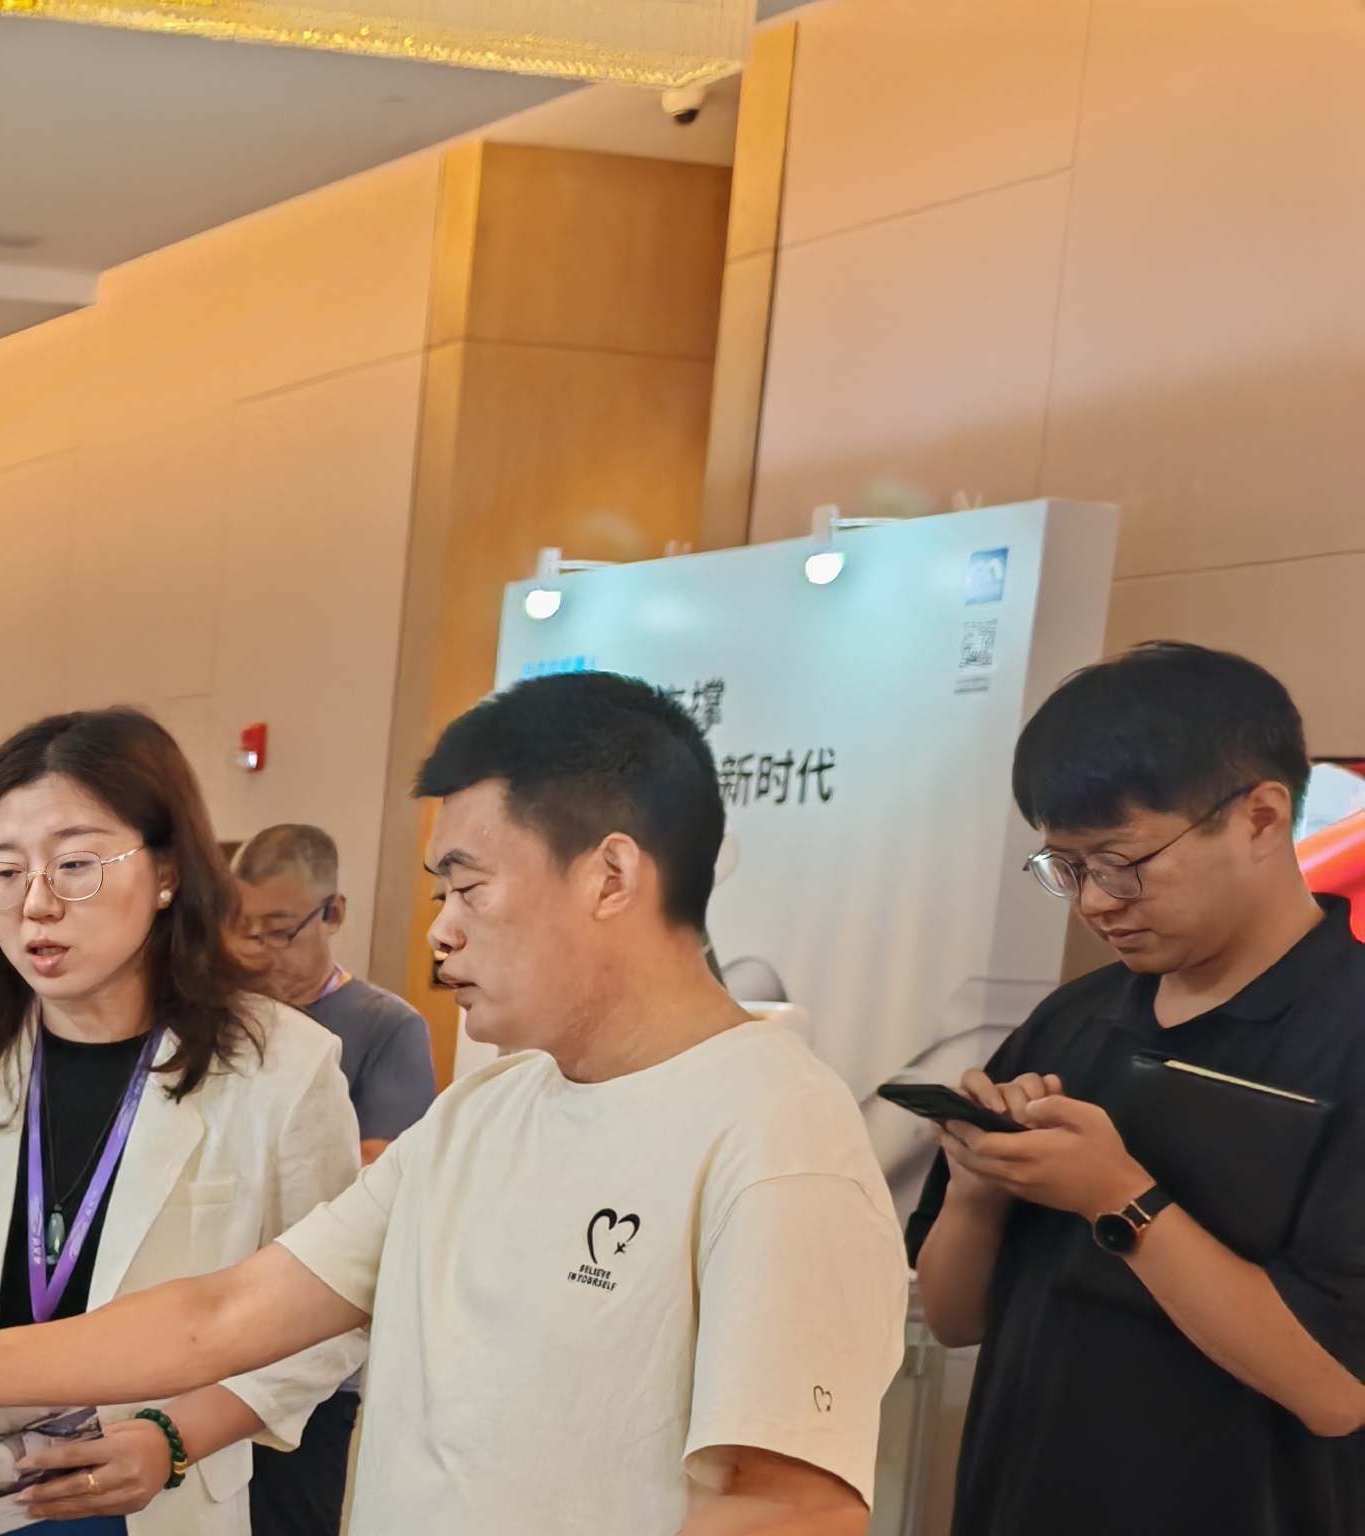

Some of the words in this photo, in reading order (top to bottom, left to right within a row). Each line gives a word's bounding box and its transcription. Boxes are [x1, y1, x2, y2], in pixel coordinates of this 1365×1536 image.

[719, 747, 836, 807] 新时代
[579, 1264, 611, 1279] BELIEVE
[577, 1274, 617, 1291] YOURSELF
